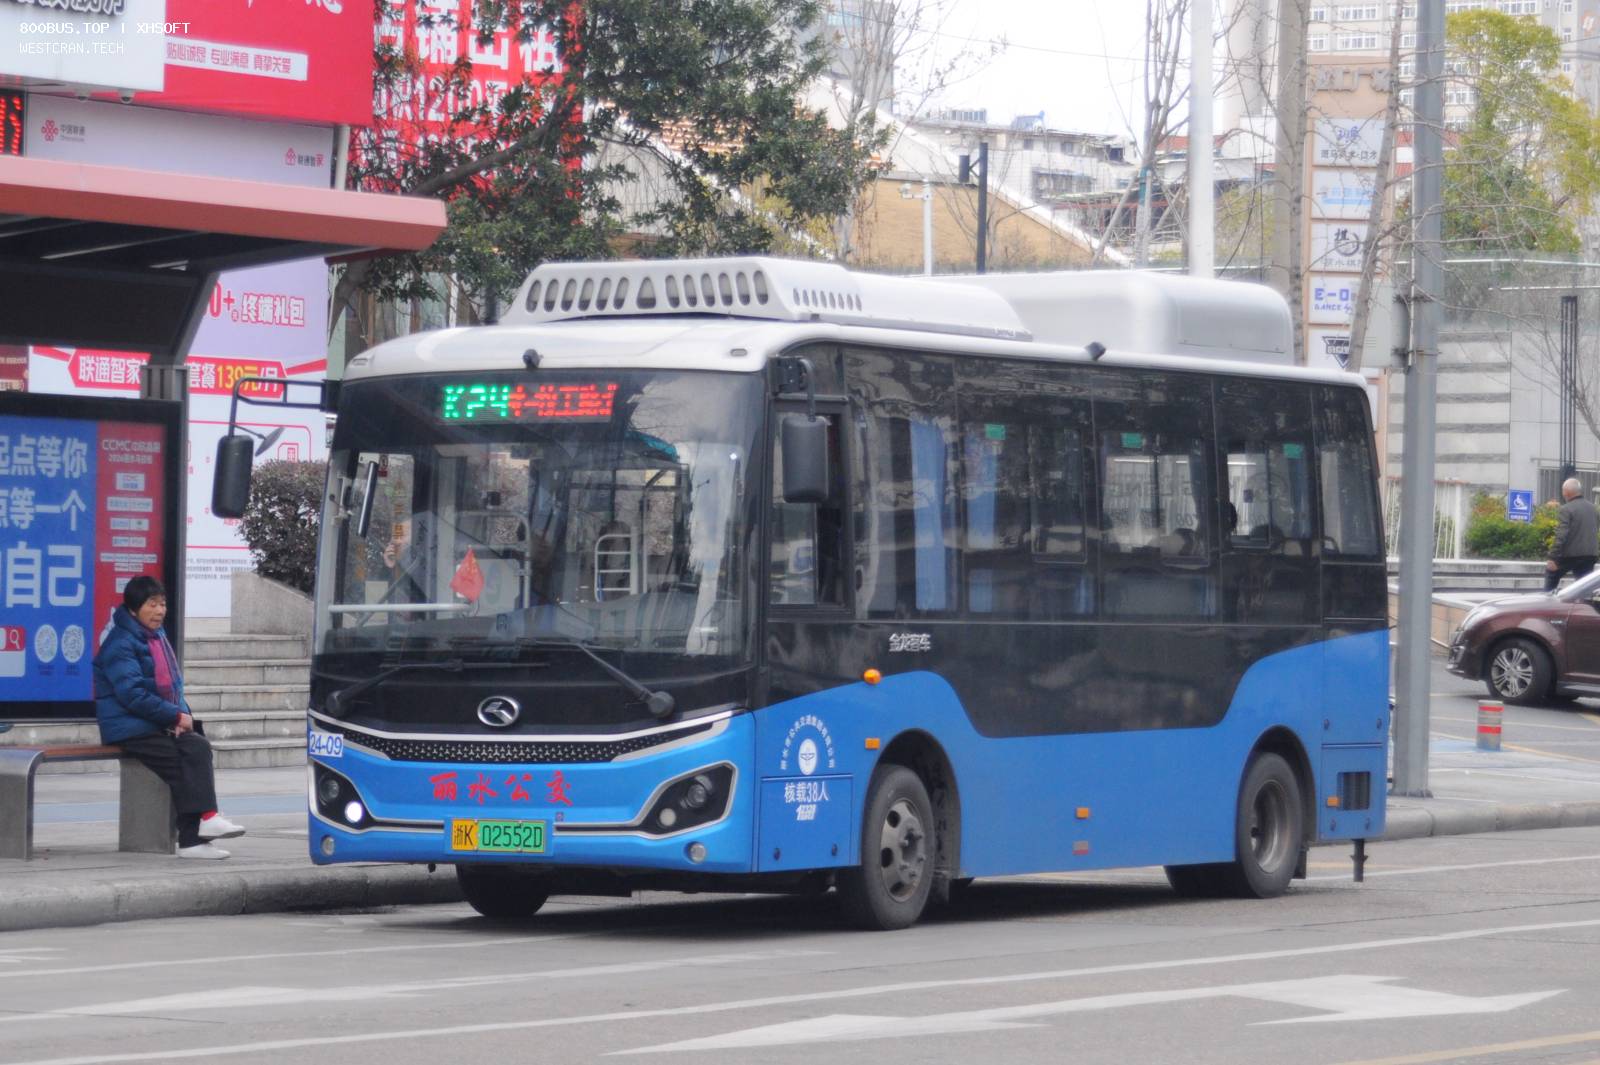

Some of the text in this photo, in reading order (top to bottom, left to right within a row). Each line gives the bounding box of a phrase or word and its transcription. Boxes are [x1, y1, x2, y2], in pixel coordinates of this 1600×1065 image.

[241, 293, 305, 327] 终端礼包
[6, 540, 87, 608] 自己
[309, 733, 343, 755] 24-09
[430, 770, 573, 807] 丽水公交
[784, 780, 829, 803] 核载38人
